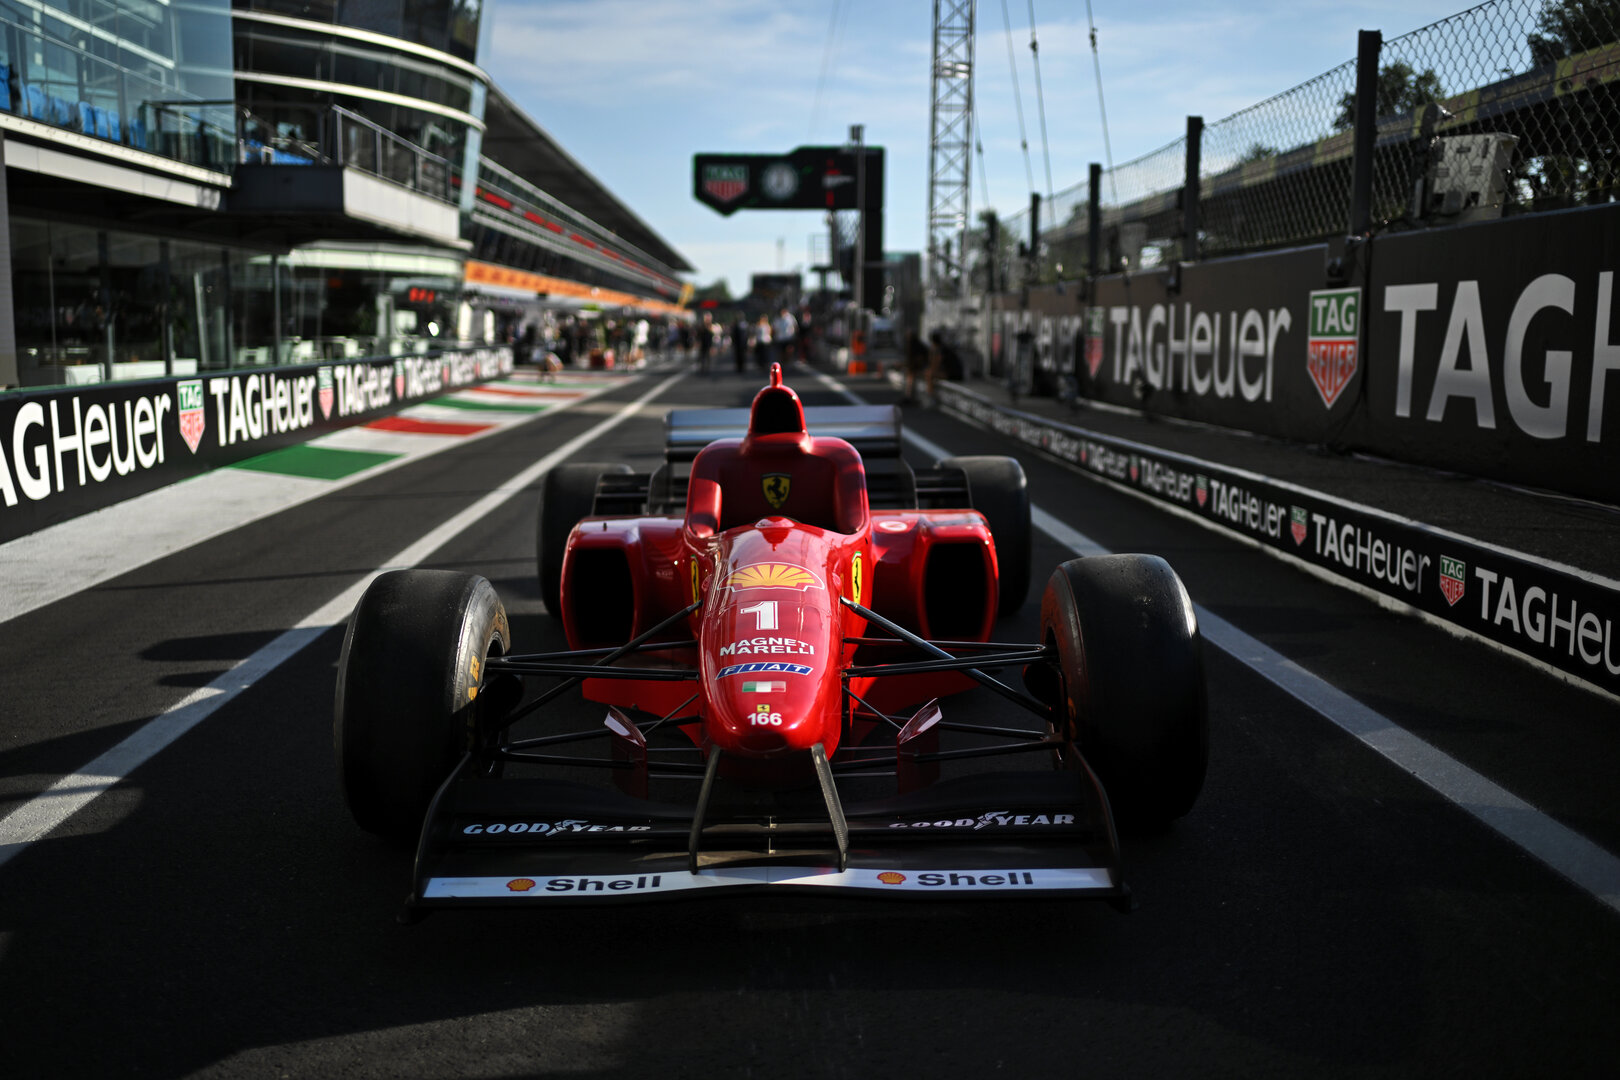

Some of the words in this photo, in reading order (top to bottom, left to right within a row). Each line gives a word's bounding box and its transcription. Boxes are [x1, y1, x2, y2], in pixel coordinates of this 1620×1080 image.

[1314, 297, 1355, 332] TAG
[1110, 303, 1291, 402] TAGHeuer
[210, 373, 316, 447] TAGHeuer
[0, 393, 171, 507] GHeuer
[1210, 479, 1286, 538] TAGHeuer
[1312, 513, 1431, 594] TAGHeuer
[1442, 559, 1463, 579] TAG
[1440, 577, 1464, 602] HEUER
[741, 601, 778, 630] 1
[720, 643, 815, 656] MARELLI
[722, 637, 814, 650] MAGNETI
[724, 664, 806, 675] FIAT
[747, 713, 783, 726] 166
[545, 875, 661, 892] Shell
[917, 872, 1033, 886] Shell
